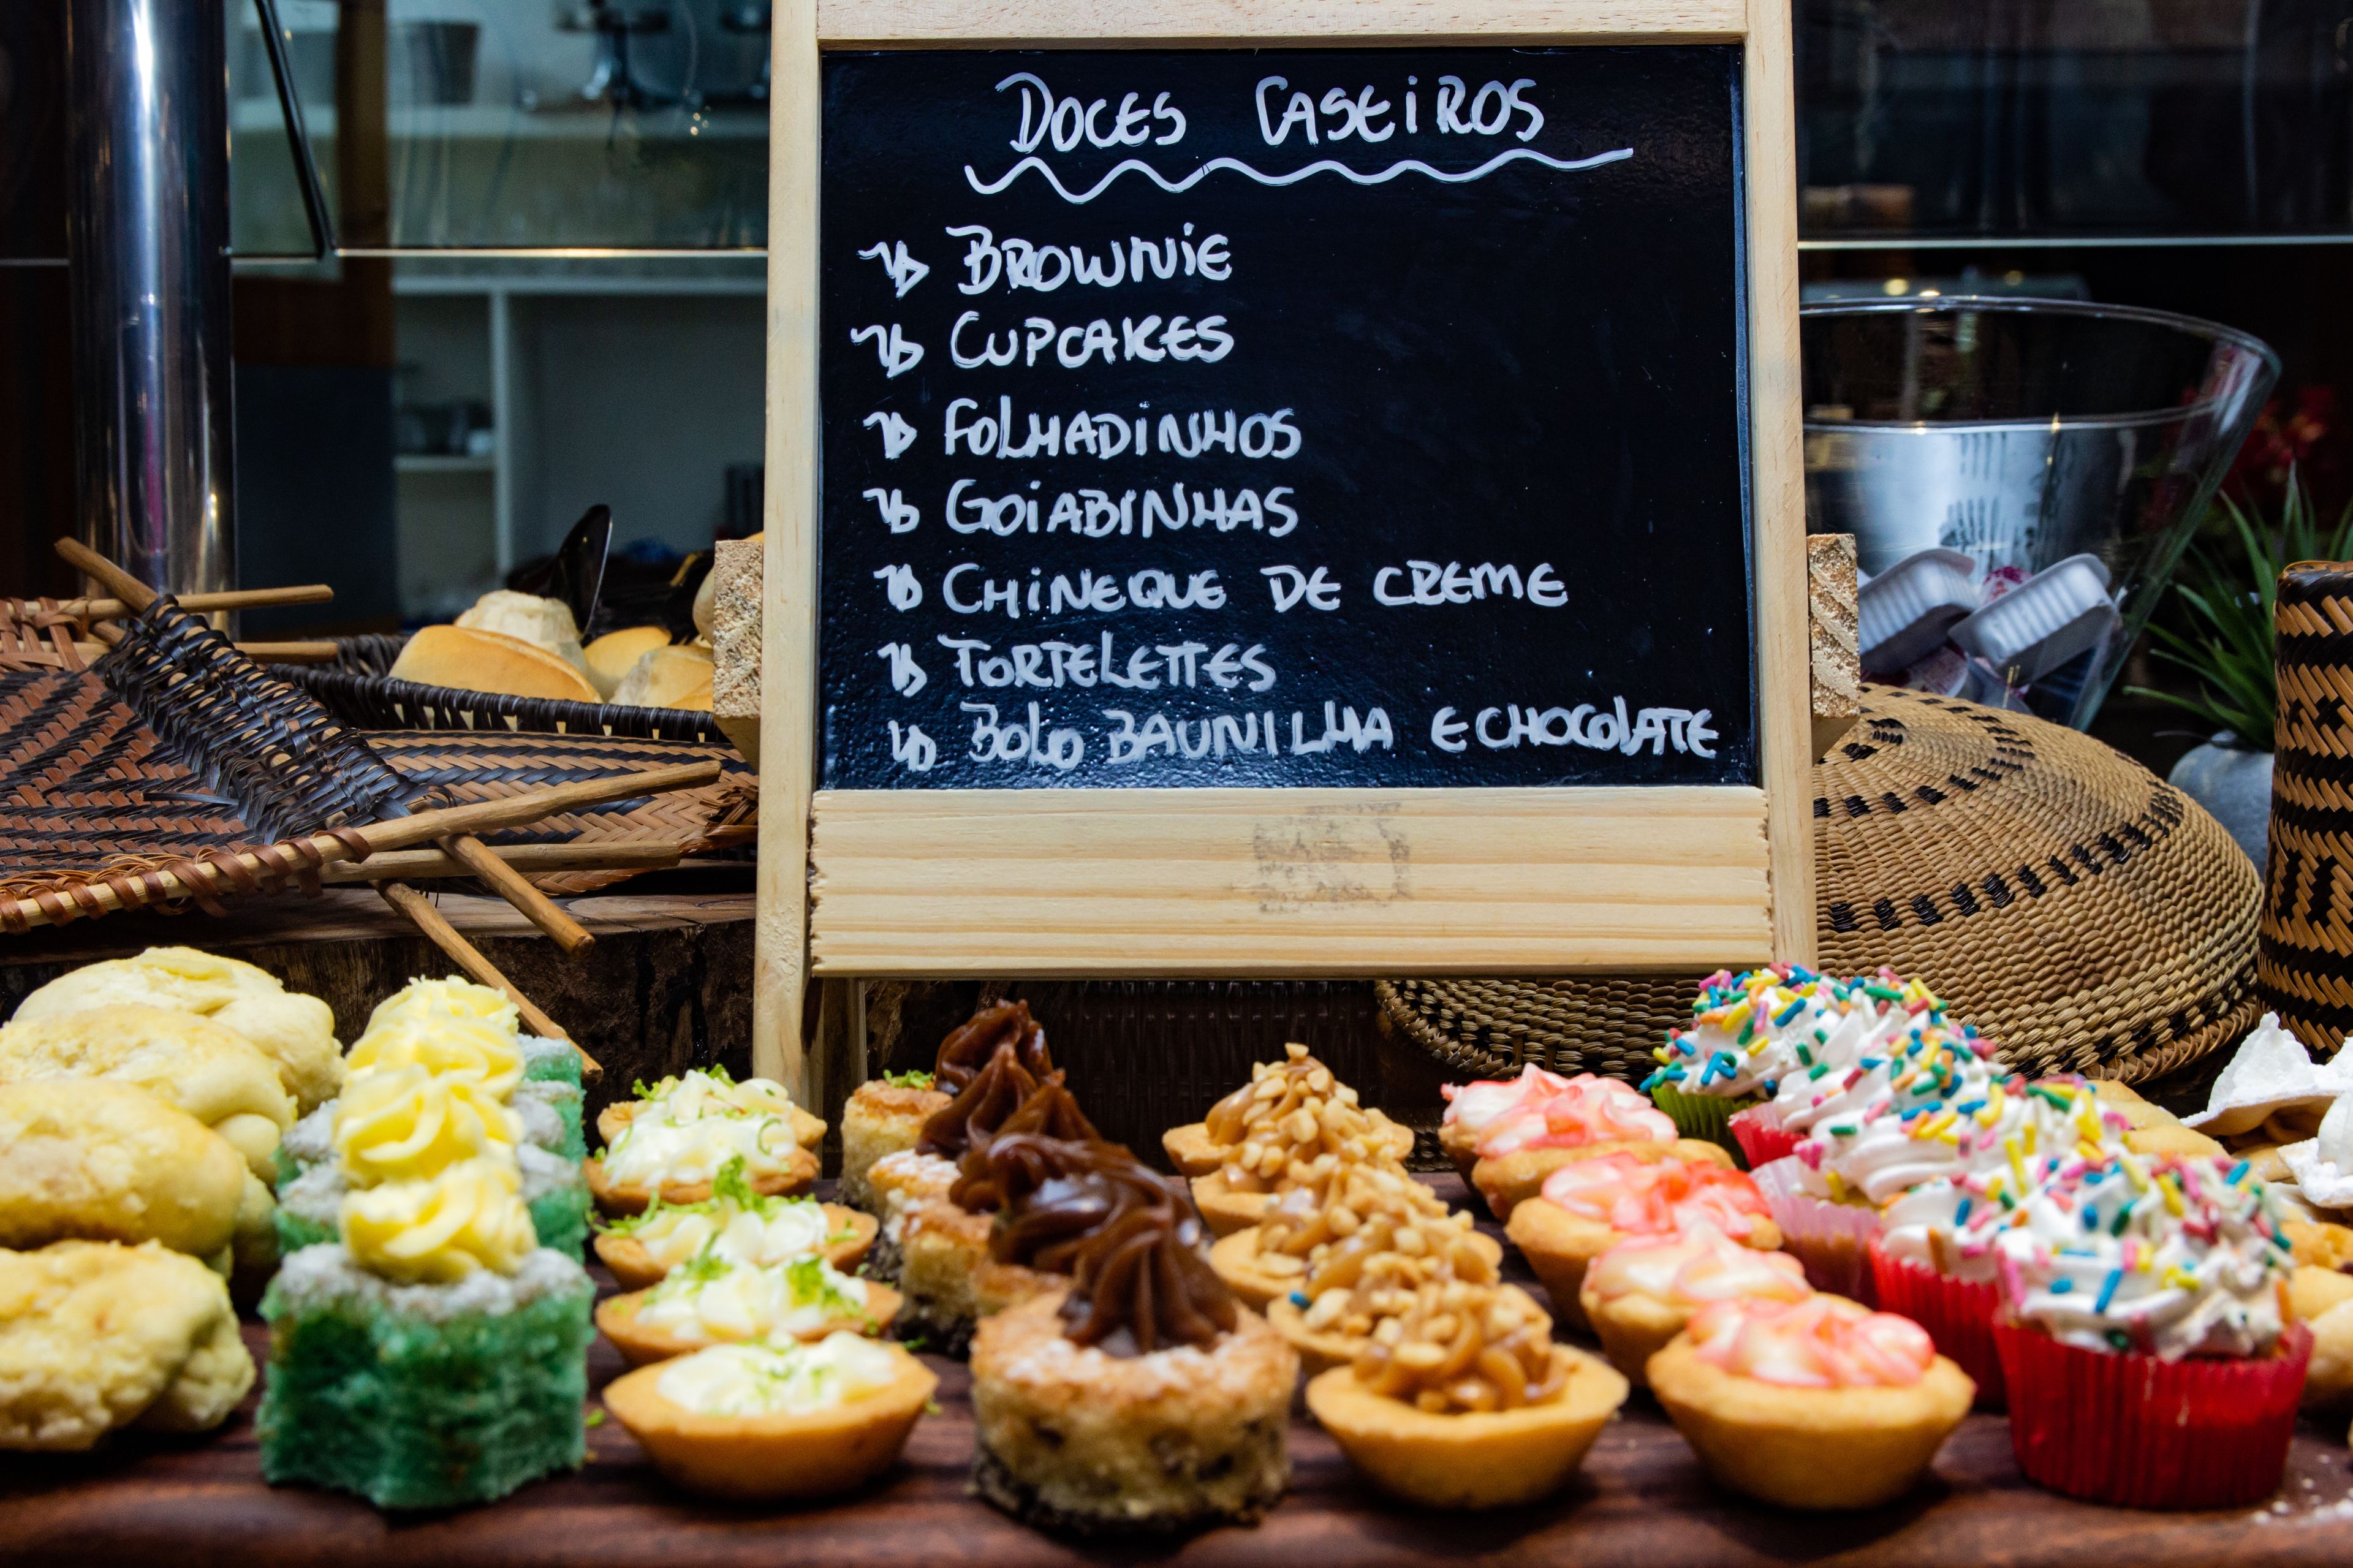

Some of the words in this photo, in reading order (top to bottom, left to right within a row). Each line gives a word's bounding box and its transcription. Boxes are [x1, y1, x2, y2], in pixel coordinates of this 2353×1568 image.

[995, 72, 1187, 153] DOCES
[950, 310, 1234, 369] CUPCAKES
[1260, 565, 1341, 613] DE
[1373, 560, 1569, 607] CREME
[937, 630, 1276, 692] TORTELETTES
[960, 700, 1085, 771] BOLO
[1102, 700, 1394, 765] BAUNILHA
